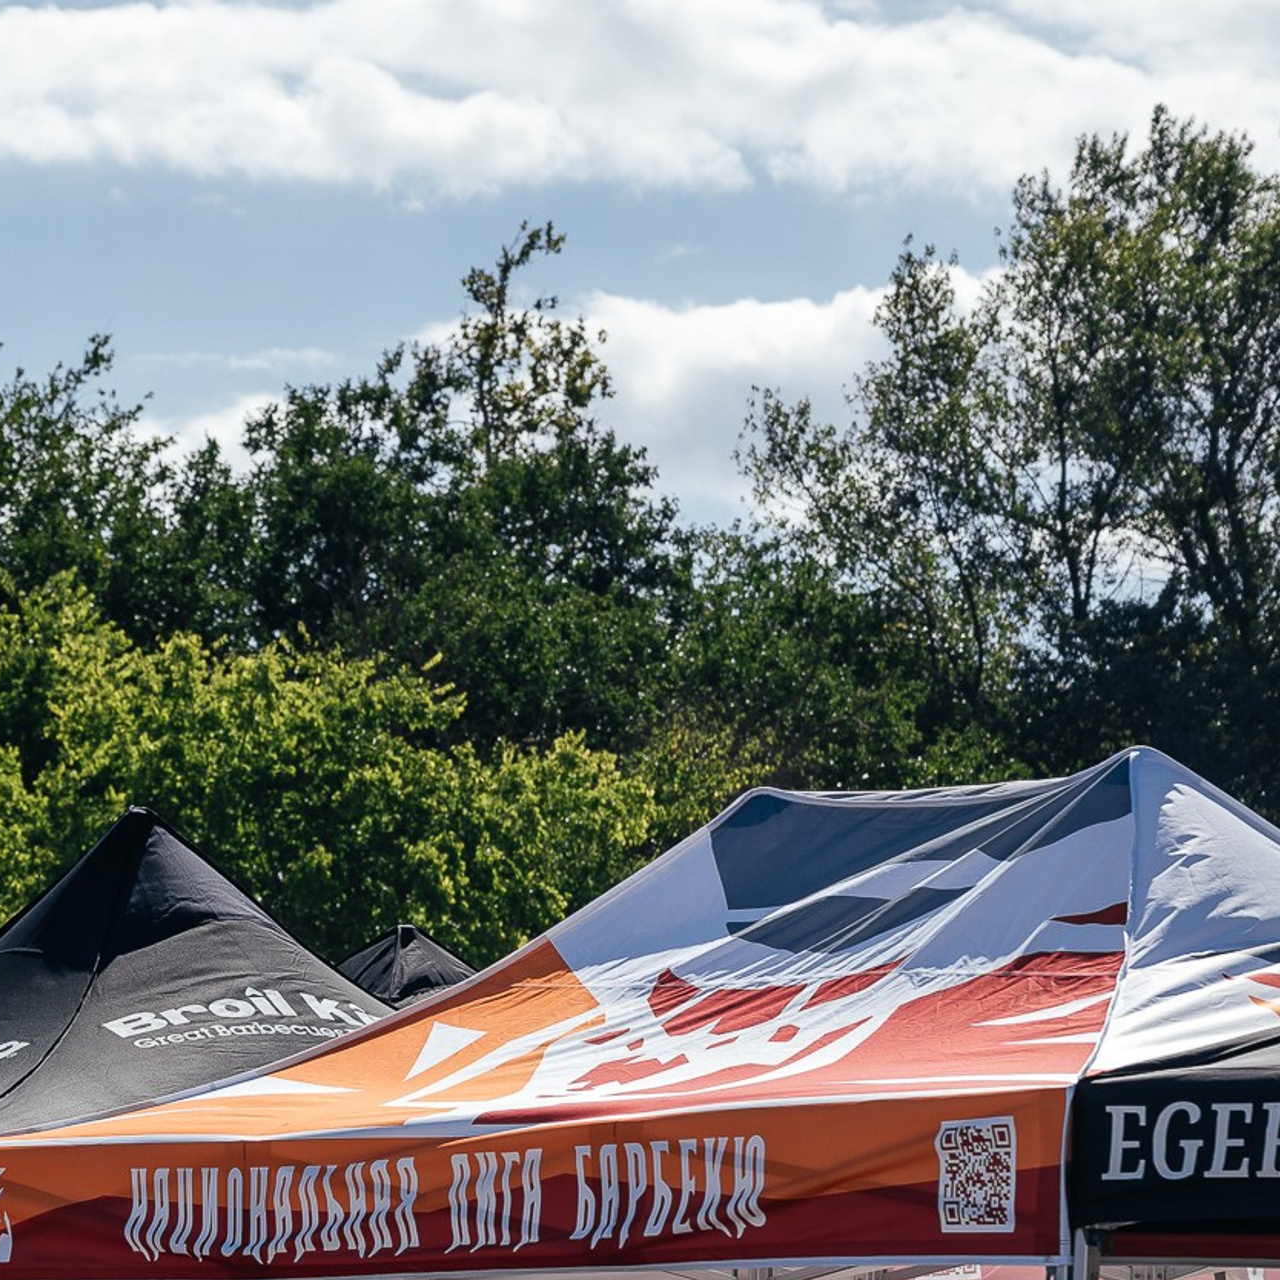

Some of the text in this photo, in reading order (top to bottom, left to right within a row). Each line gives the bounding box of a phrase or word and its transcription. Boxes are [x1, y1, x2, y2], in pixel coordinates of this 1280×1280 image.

[101, 985, 298, 1038] Broil
[133, 1028, 213, 1049] Great
[124, 1134, 767, 1264] НАЦИОНАЛЬНАЯ ЛИГА БАРБЕКЮ
